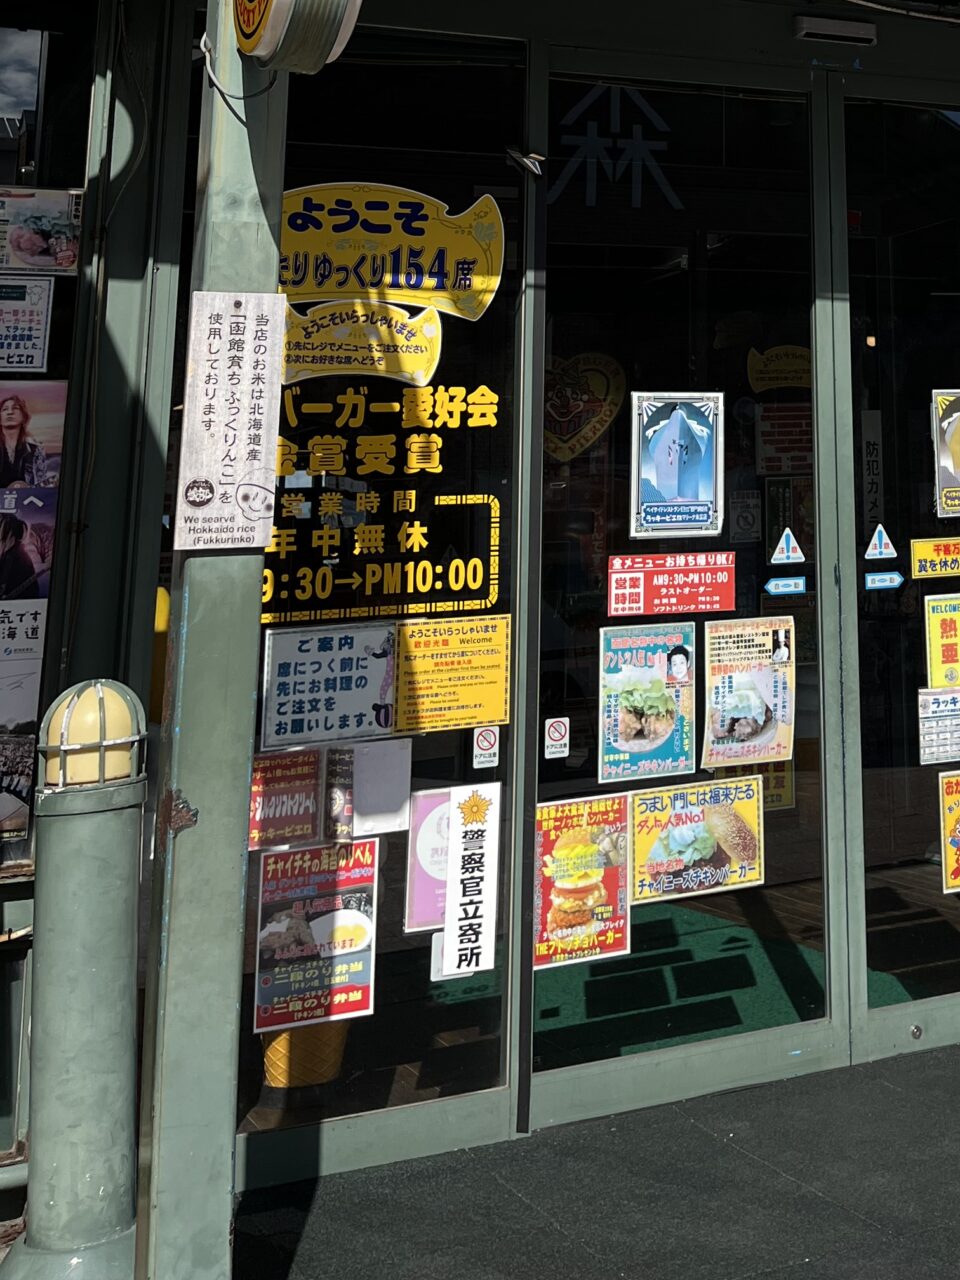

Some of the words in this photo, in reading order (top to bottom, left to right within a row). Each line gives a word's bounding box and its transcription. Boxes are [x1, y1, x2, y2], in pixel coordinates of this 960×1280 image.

[287, 196, 430, 237] ようこそ
[302, 308, 419, 343] ようこそいらっしゃいませ
[201, 312, 223, 439] 使用しております。
[246, 313, 270, 462] 当店のお米は北海道産
[281, 490, 417, 517] 営業時間
[183, 515, 200, 525] We
[188, 524, 235, 535] Hokkaido
[236, 524, 256, 534] rice
[193, 534, 256, 546] (Fukkurinko)
[269, 521, 429, 559] 年中無休
[614, 577, 641, 590] 営業
[660, 586, 713, 595] ラストオーダー
[614, 591, 641, 605] 時間
[653, 604, 696, 612] ソフトドリンク
[931, 603, 960, 614] WELCOME
[408, 624, 498, 639] ようこそいらっしゃいませ
[459, 636, 493, 645] Welcome
[297, 634, 355, 652] ご案内
[277, 656, 369, 677] 席につく前に
[276, 674, 369, 697] 先にお料理の
[276, 697, 337, 716] ご注文を
[274, 711, 375, 737] お願いします。
[637, 783, 755, 814] うまい門には福来たる
[638, 862, 756, 896] チャイニーズチキンバーガー
[456, 828, 488, 970] 警察官立寄所
